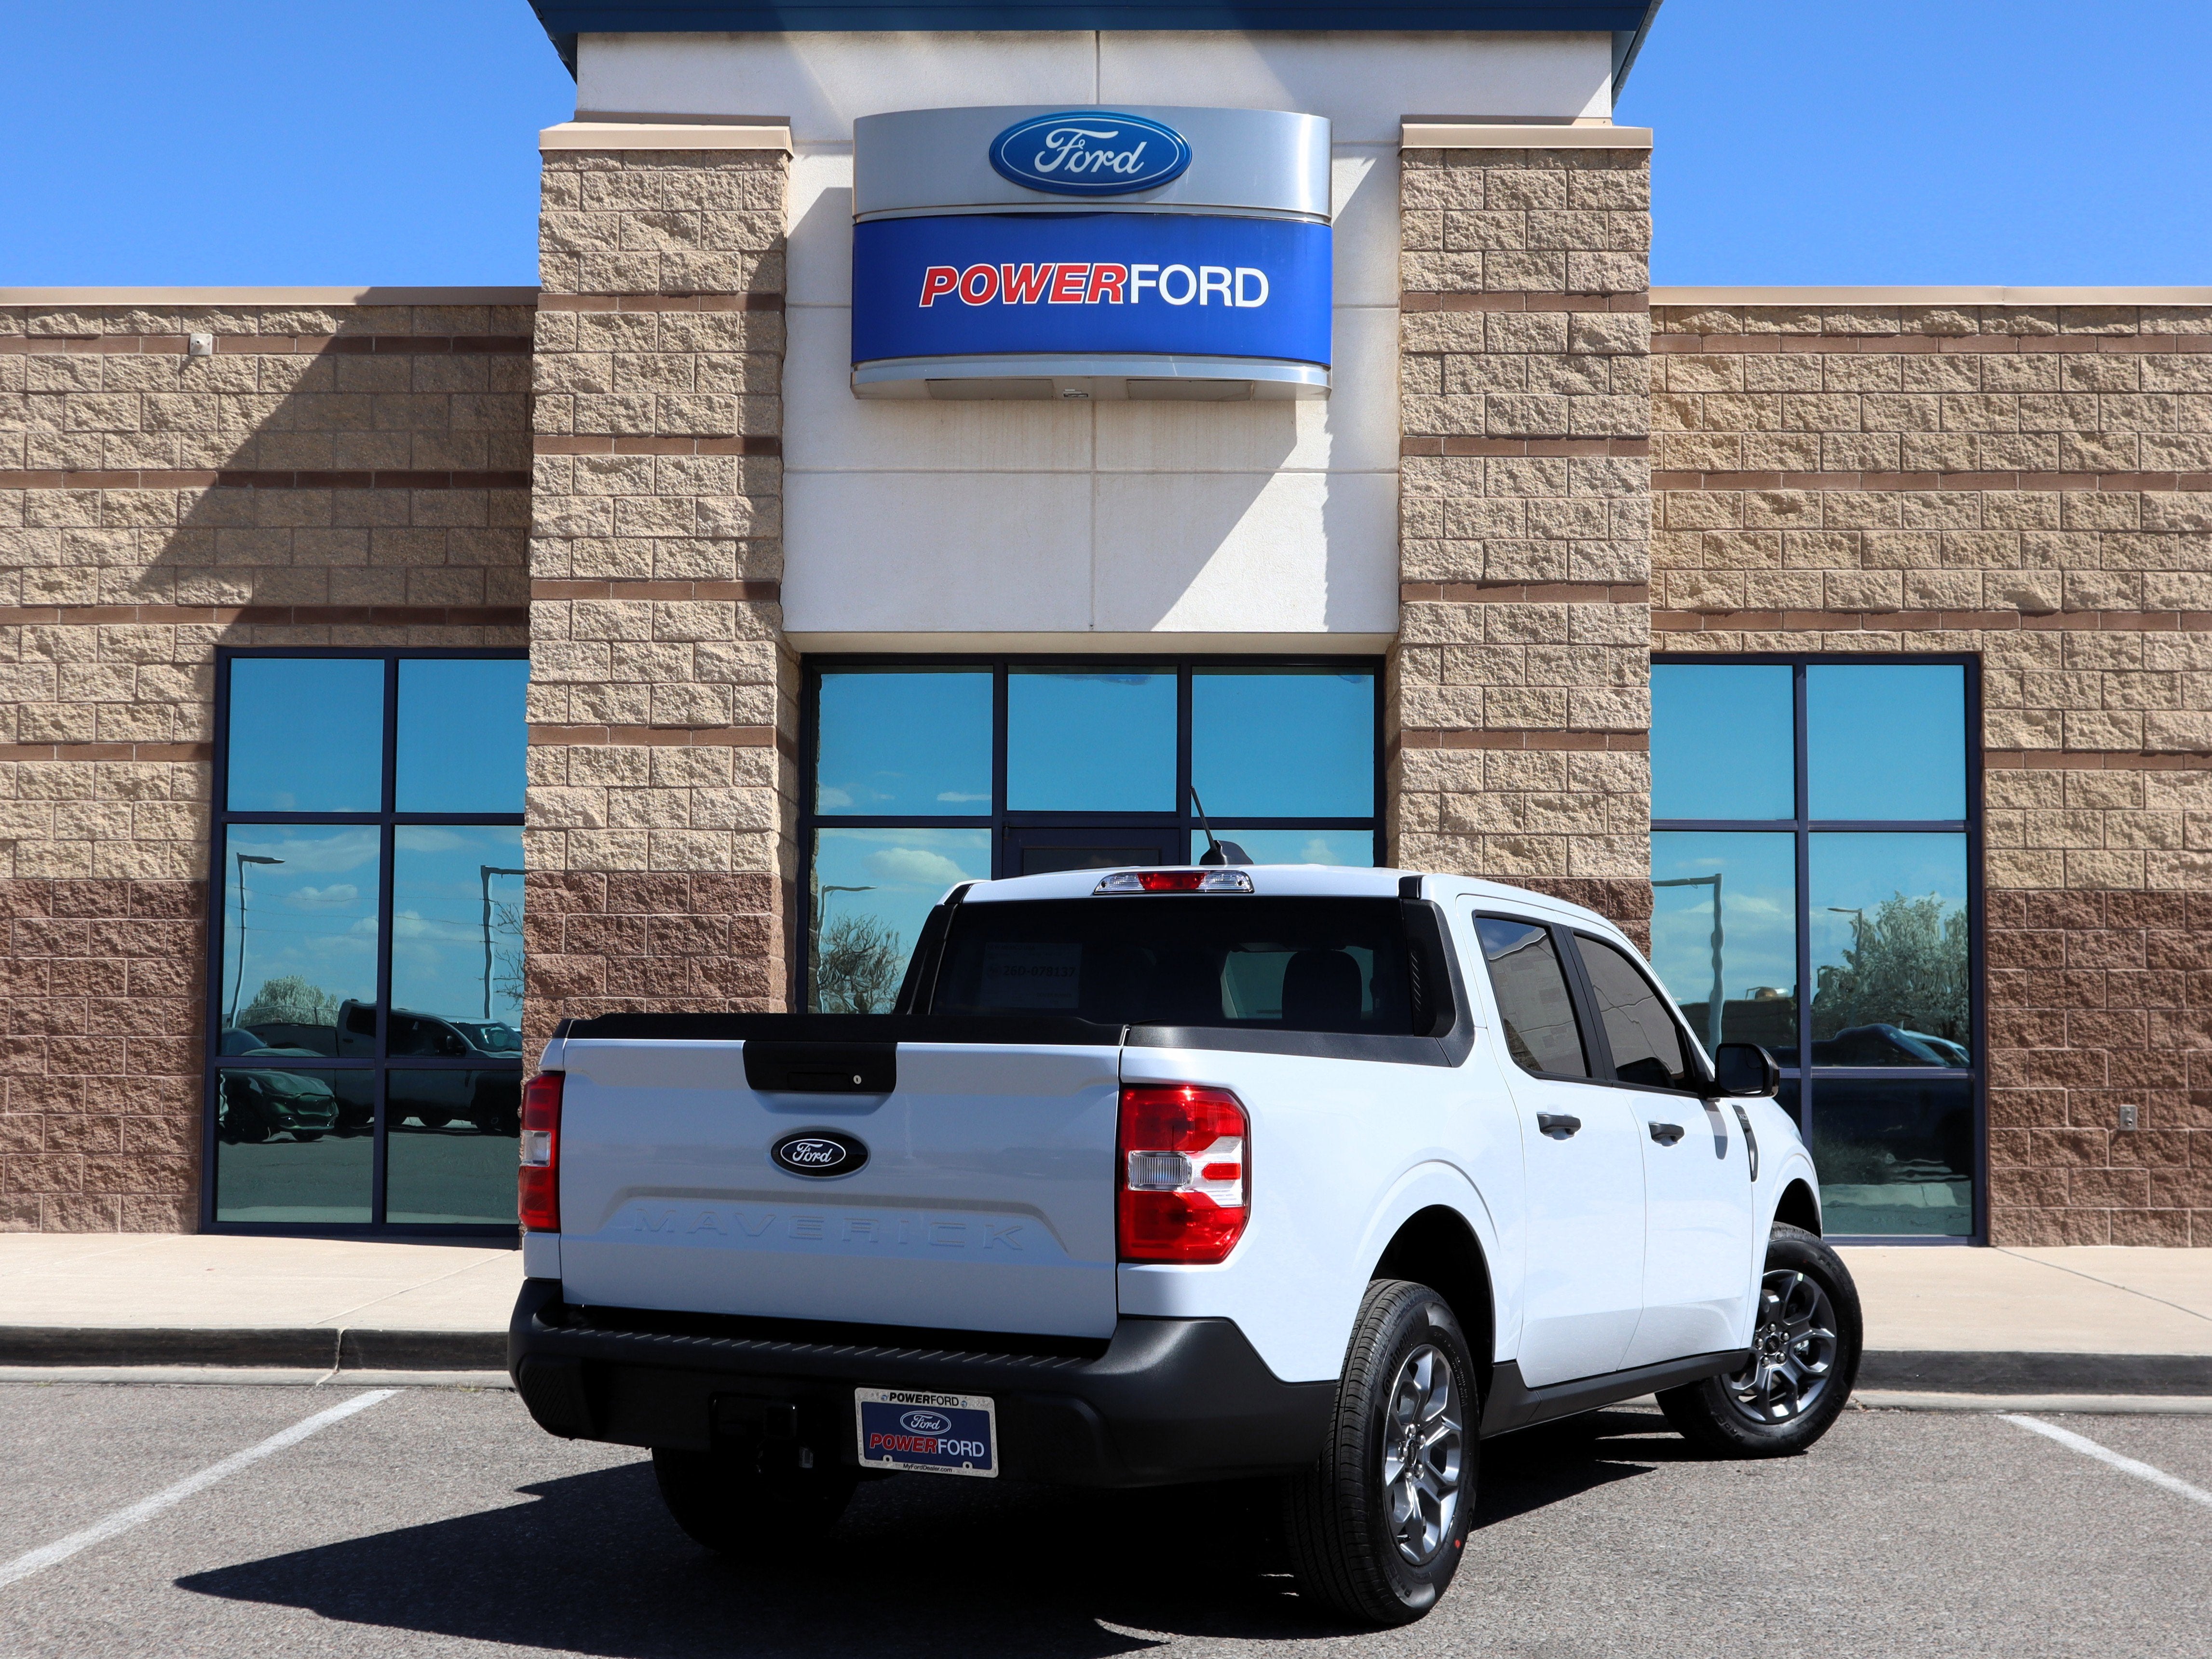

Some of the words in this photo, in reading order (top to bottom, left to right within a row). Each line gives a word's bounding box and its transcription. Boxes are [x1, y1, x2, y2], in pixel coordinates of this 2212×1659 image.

[1034, 128, 1147, 174] Ford
[919, 263, 1269, 308] POWERFORD
[792, 1142, 833, 1163] Ford
[634, 1207, 1024, 1251] MAVERICK
[889, 1392, 959, 1406] POWERFORD
[910, 1415, 940, 1430] Ford
[869, 1433, 985, 1457] POWERFORD
[903, 1463, 952, 1473] MyFordDealer.com
